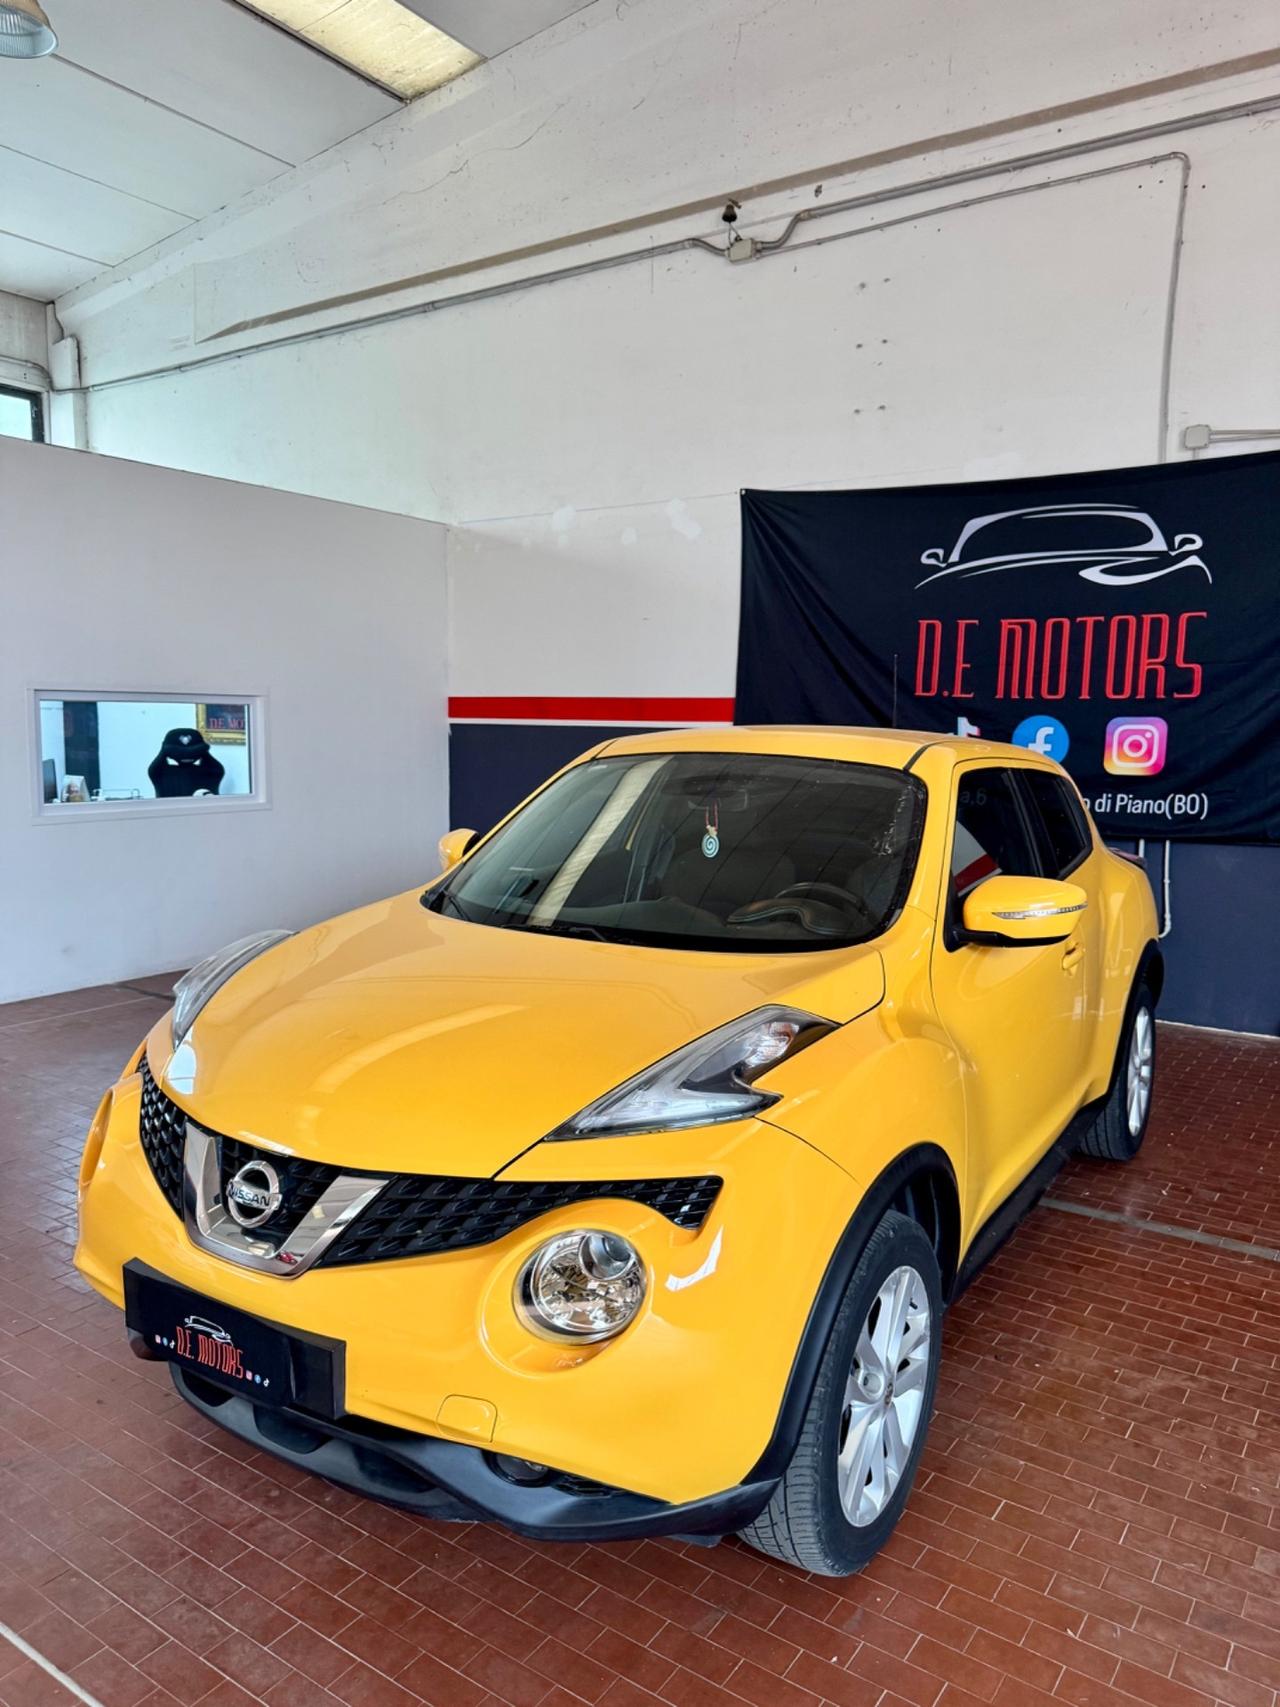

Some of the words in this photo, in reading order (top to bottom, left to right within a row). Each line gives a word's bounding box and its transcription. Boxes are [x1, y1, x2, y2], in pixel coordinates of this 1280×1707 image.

[914, 619, 979, 698] D.E
[995, 611, 1208, 700] MOTORS
[1094, 792, 1112, 813] di
[1115, 792, 1209, 820] Piano(BO)
[228, 1181, 271, 1207] NISSAN
[197, 1333, 244, 1379] MOTORS
